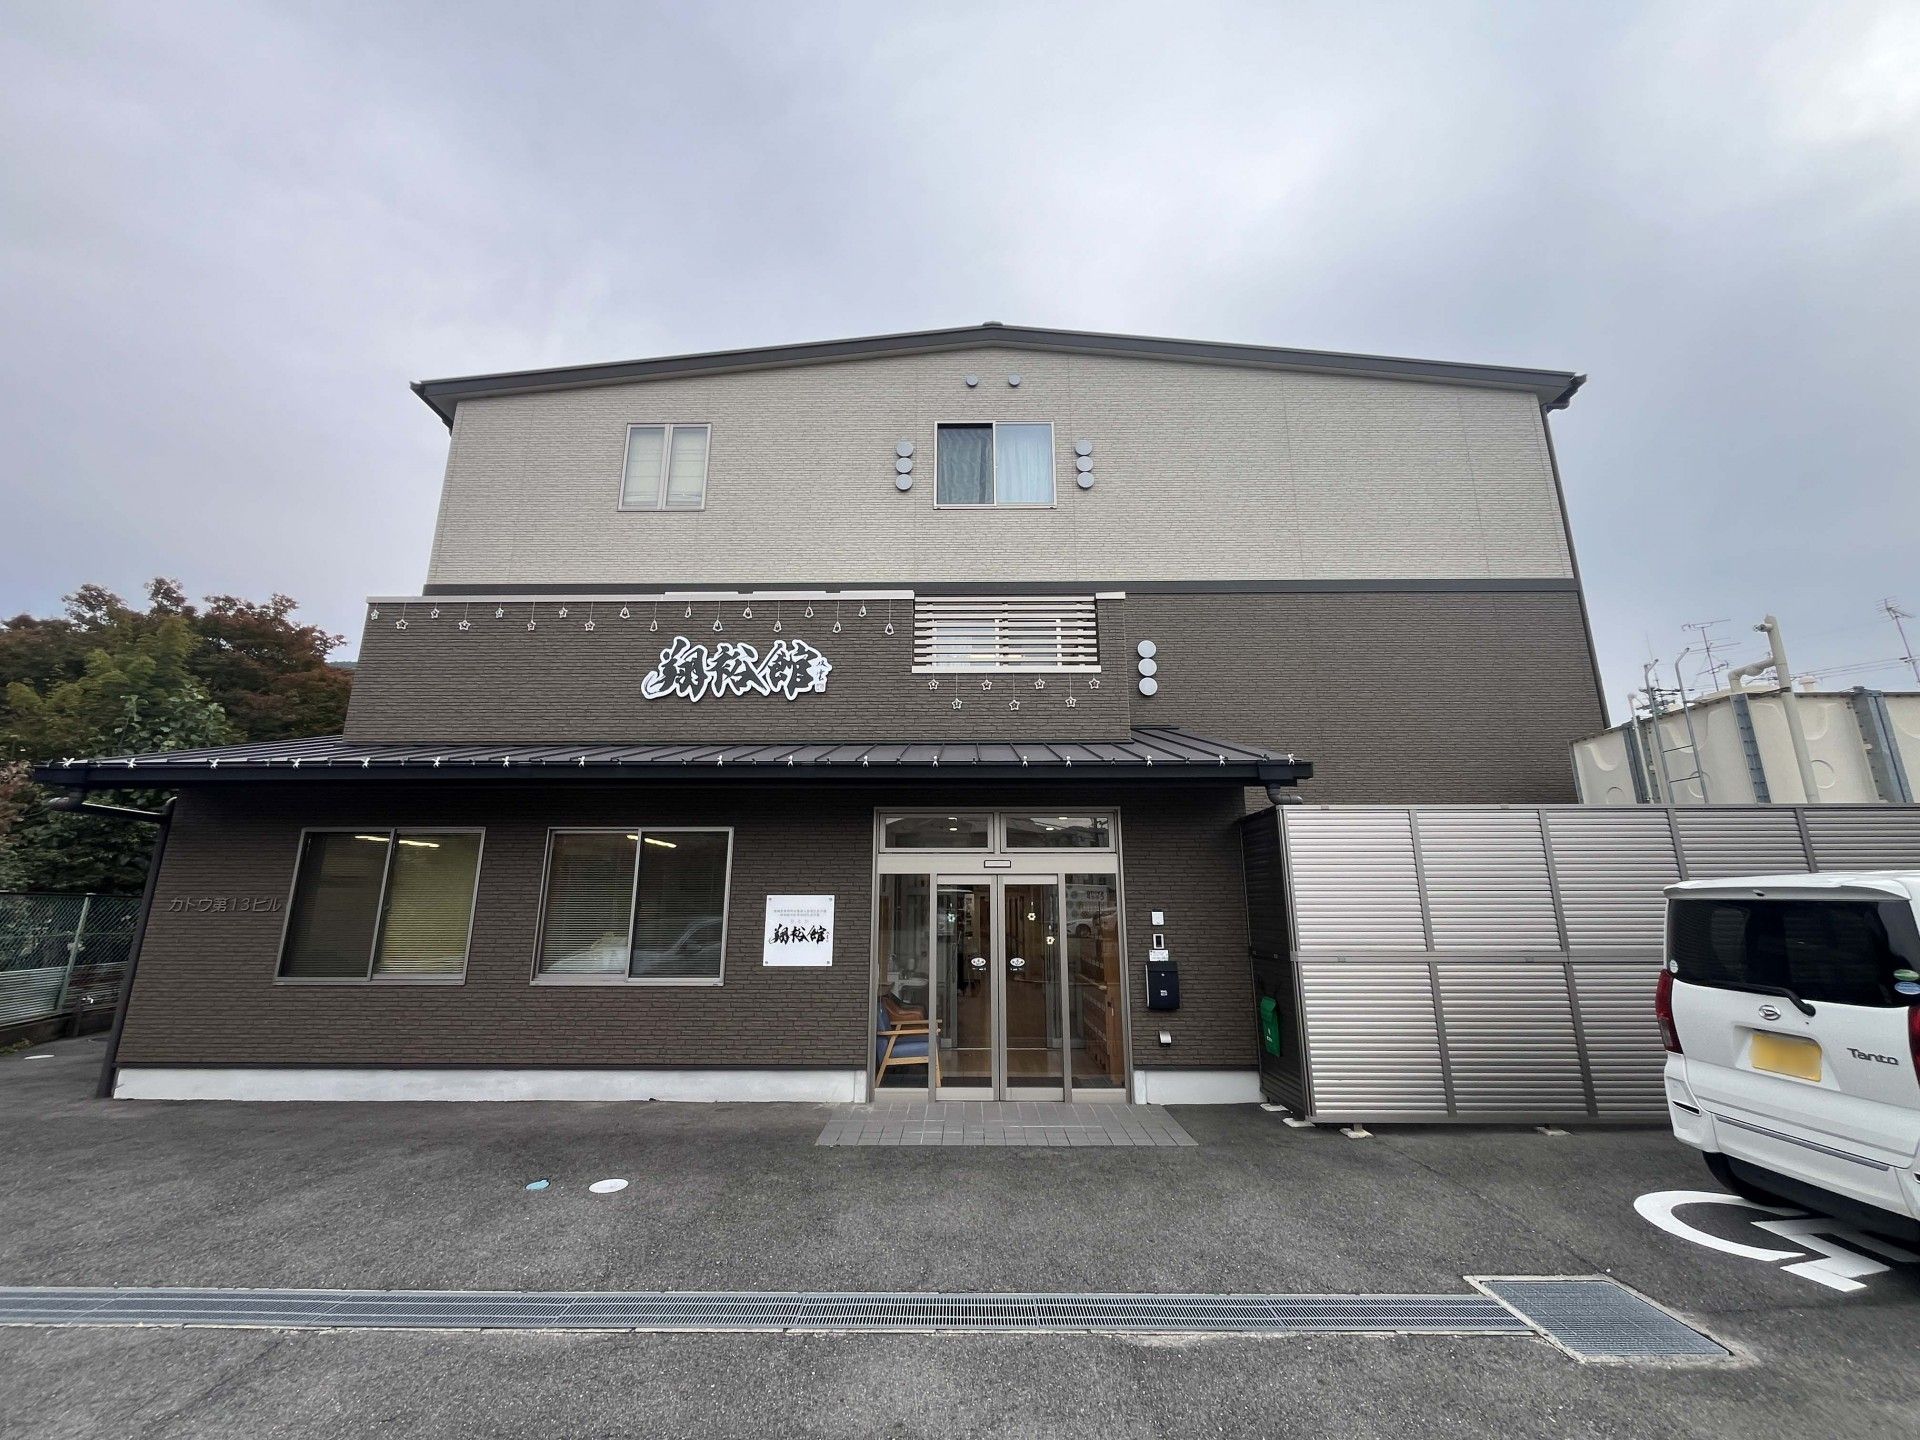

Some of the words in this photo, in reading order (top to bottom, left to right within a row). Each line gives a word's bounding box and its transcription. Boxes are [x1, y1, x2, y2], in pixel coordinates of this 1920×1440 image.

[168, 897, 282, 913] カトウ第13ビル
[1846, 1047, 1899, 1066] Tanto
